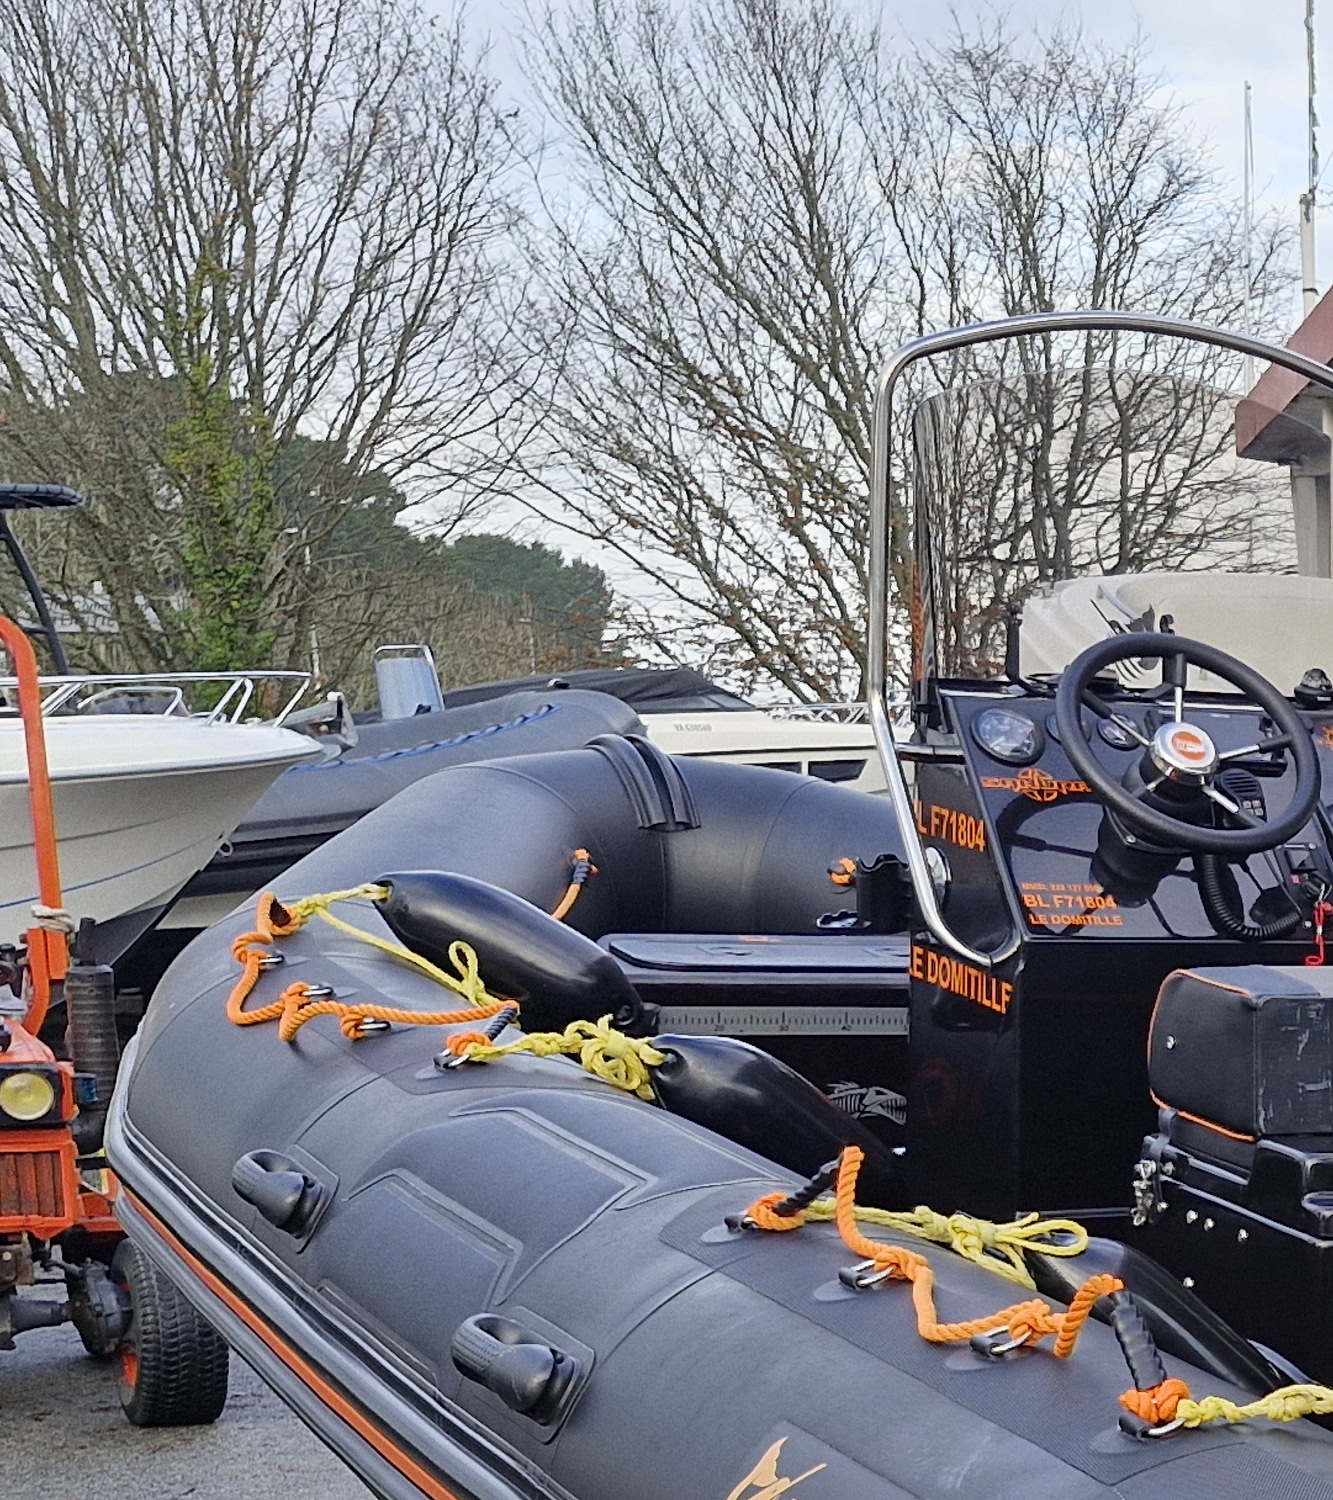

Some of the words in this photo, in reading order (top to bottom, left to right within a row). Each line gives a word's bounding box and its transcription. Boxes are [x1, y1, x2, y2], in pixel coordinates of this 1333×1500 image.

[915, 799, 927, 835] L
[930, 804, 986, 852] F71804
[1022, 893, 1050, 909] BL
[1052, 894, 1118, 909] F71804
[1028, 913, 1048, 925] LE
[1050, 914, 1123, 926] DOMITILLE
